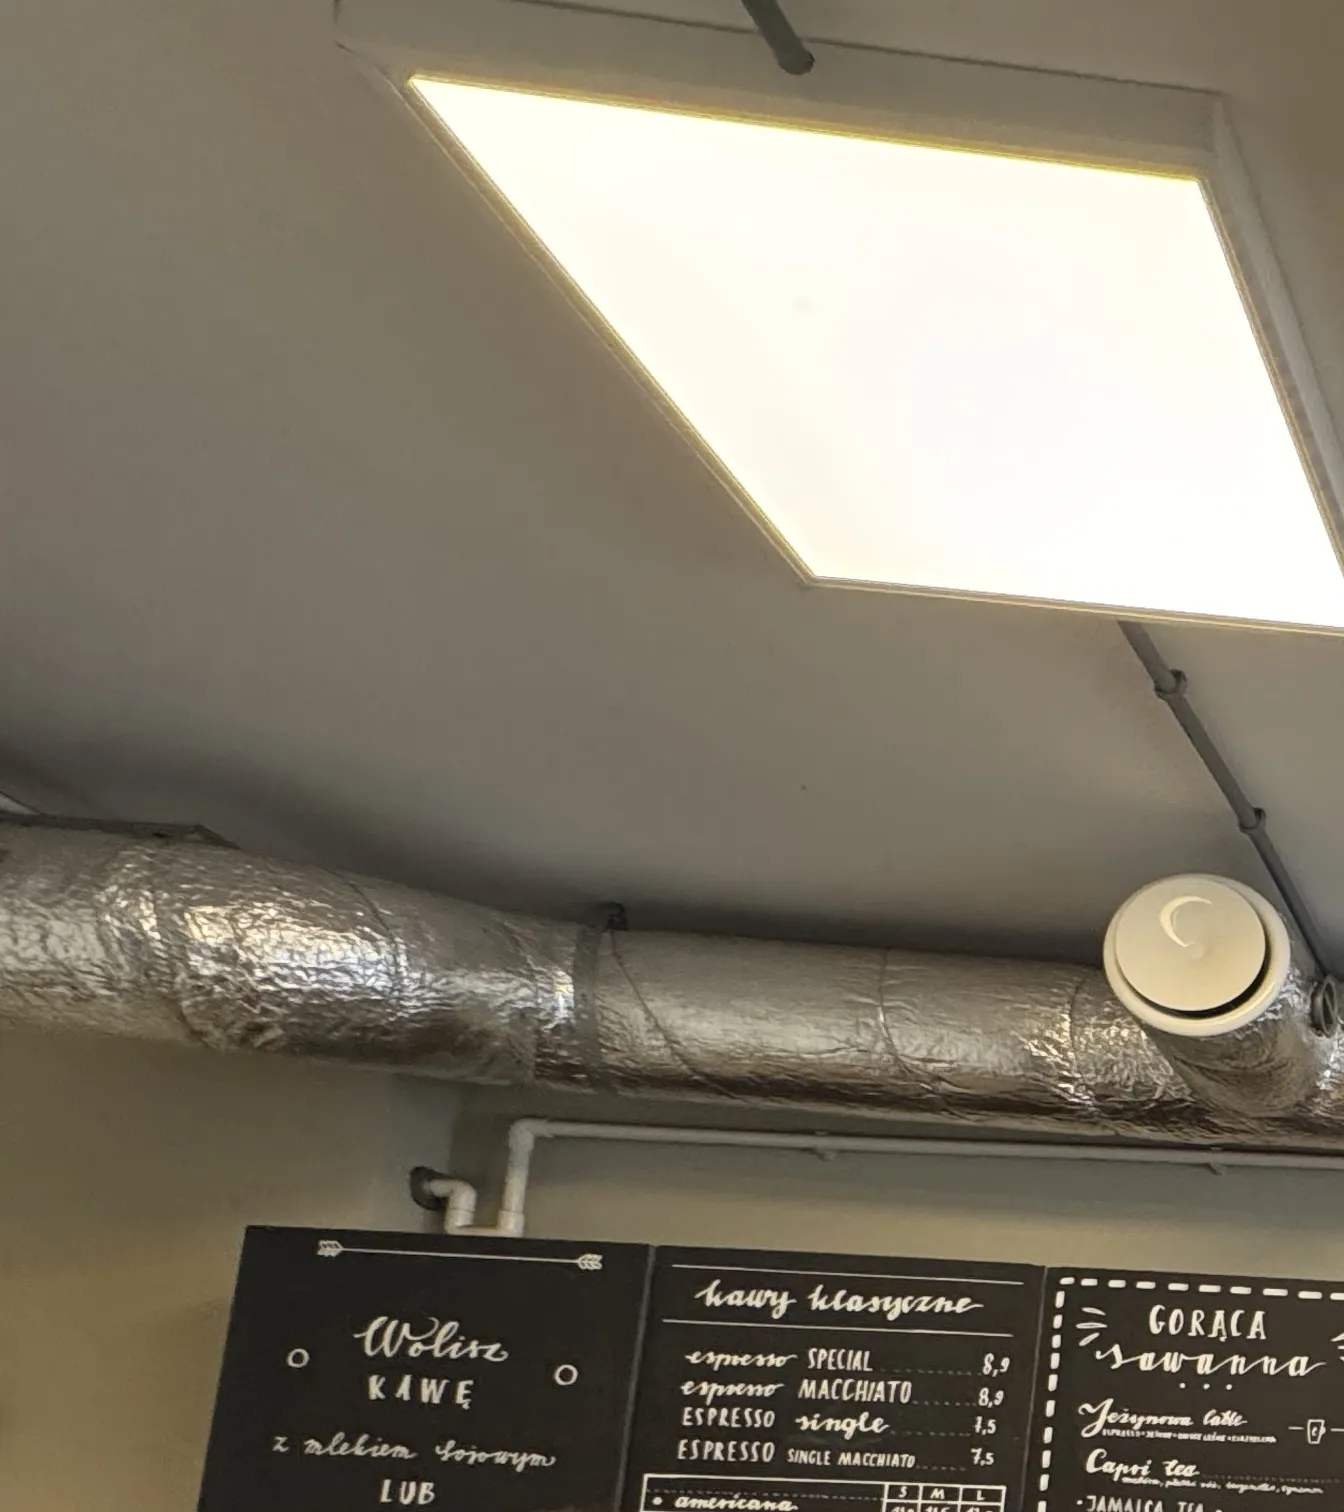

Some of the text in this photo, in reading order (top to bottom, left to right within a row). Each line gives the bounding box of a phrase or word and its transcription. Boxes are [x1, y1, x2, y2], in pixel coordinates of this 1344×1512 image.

[694, 1279, 984, 1322] kawy klasyczne
[353, 1316, 509, 1362] Wolisz
[1148, 1304, 1267, 1342] GORĄCA
[684, 1347, 1010, 1378] espresso SPECIAL 8,9
[368, 1374, 474, 1410] KAWĘ
[680, 1378, 1004, 1409] espresso MACCHIATO 8,9
[682, 1406, 997, 1441] ESPRESSO single 7,5
[303, 1431, 417, 1460] mlekiem
[434, 1439, 556, 1473] sojowym
[677, 1438, 995, 1469] ESPRESSO SINGLE MACCHIATO 7,5
[1086, 1448, 1152, 1482] Capri
[1162, 1459, 1200, 1477] tea
[380, 1478, 435, 1505] LUB
[674, 1493, 799, 1512] americana
[898, 1485, 985, 1501] S M L
